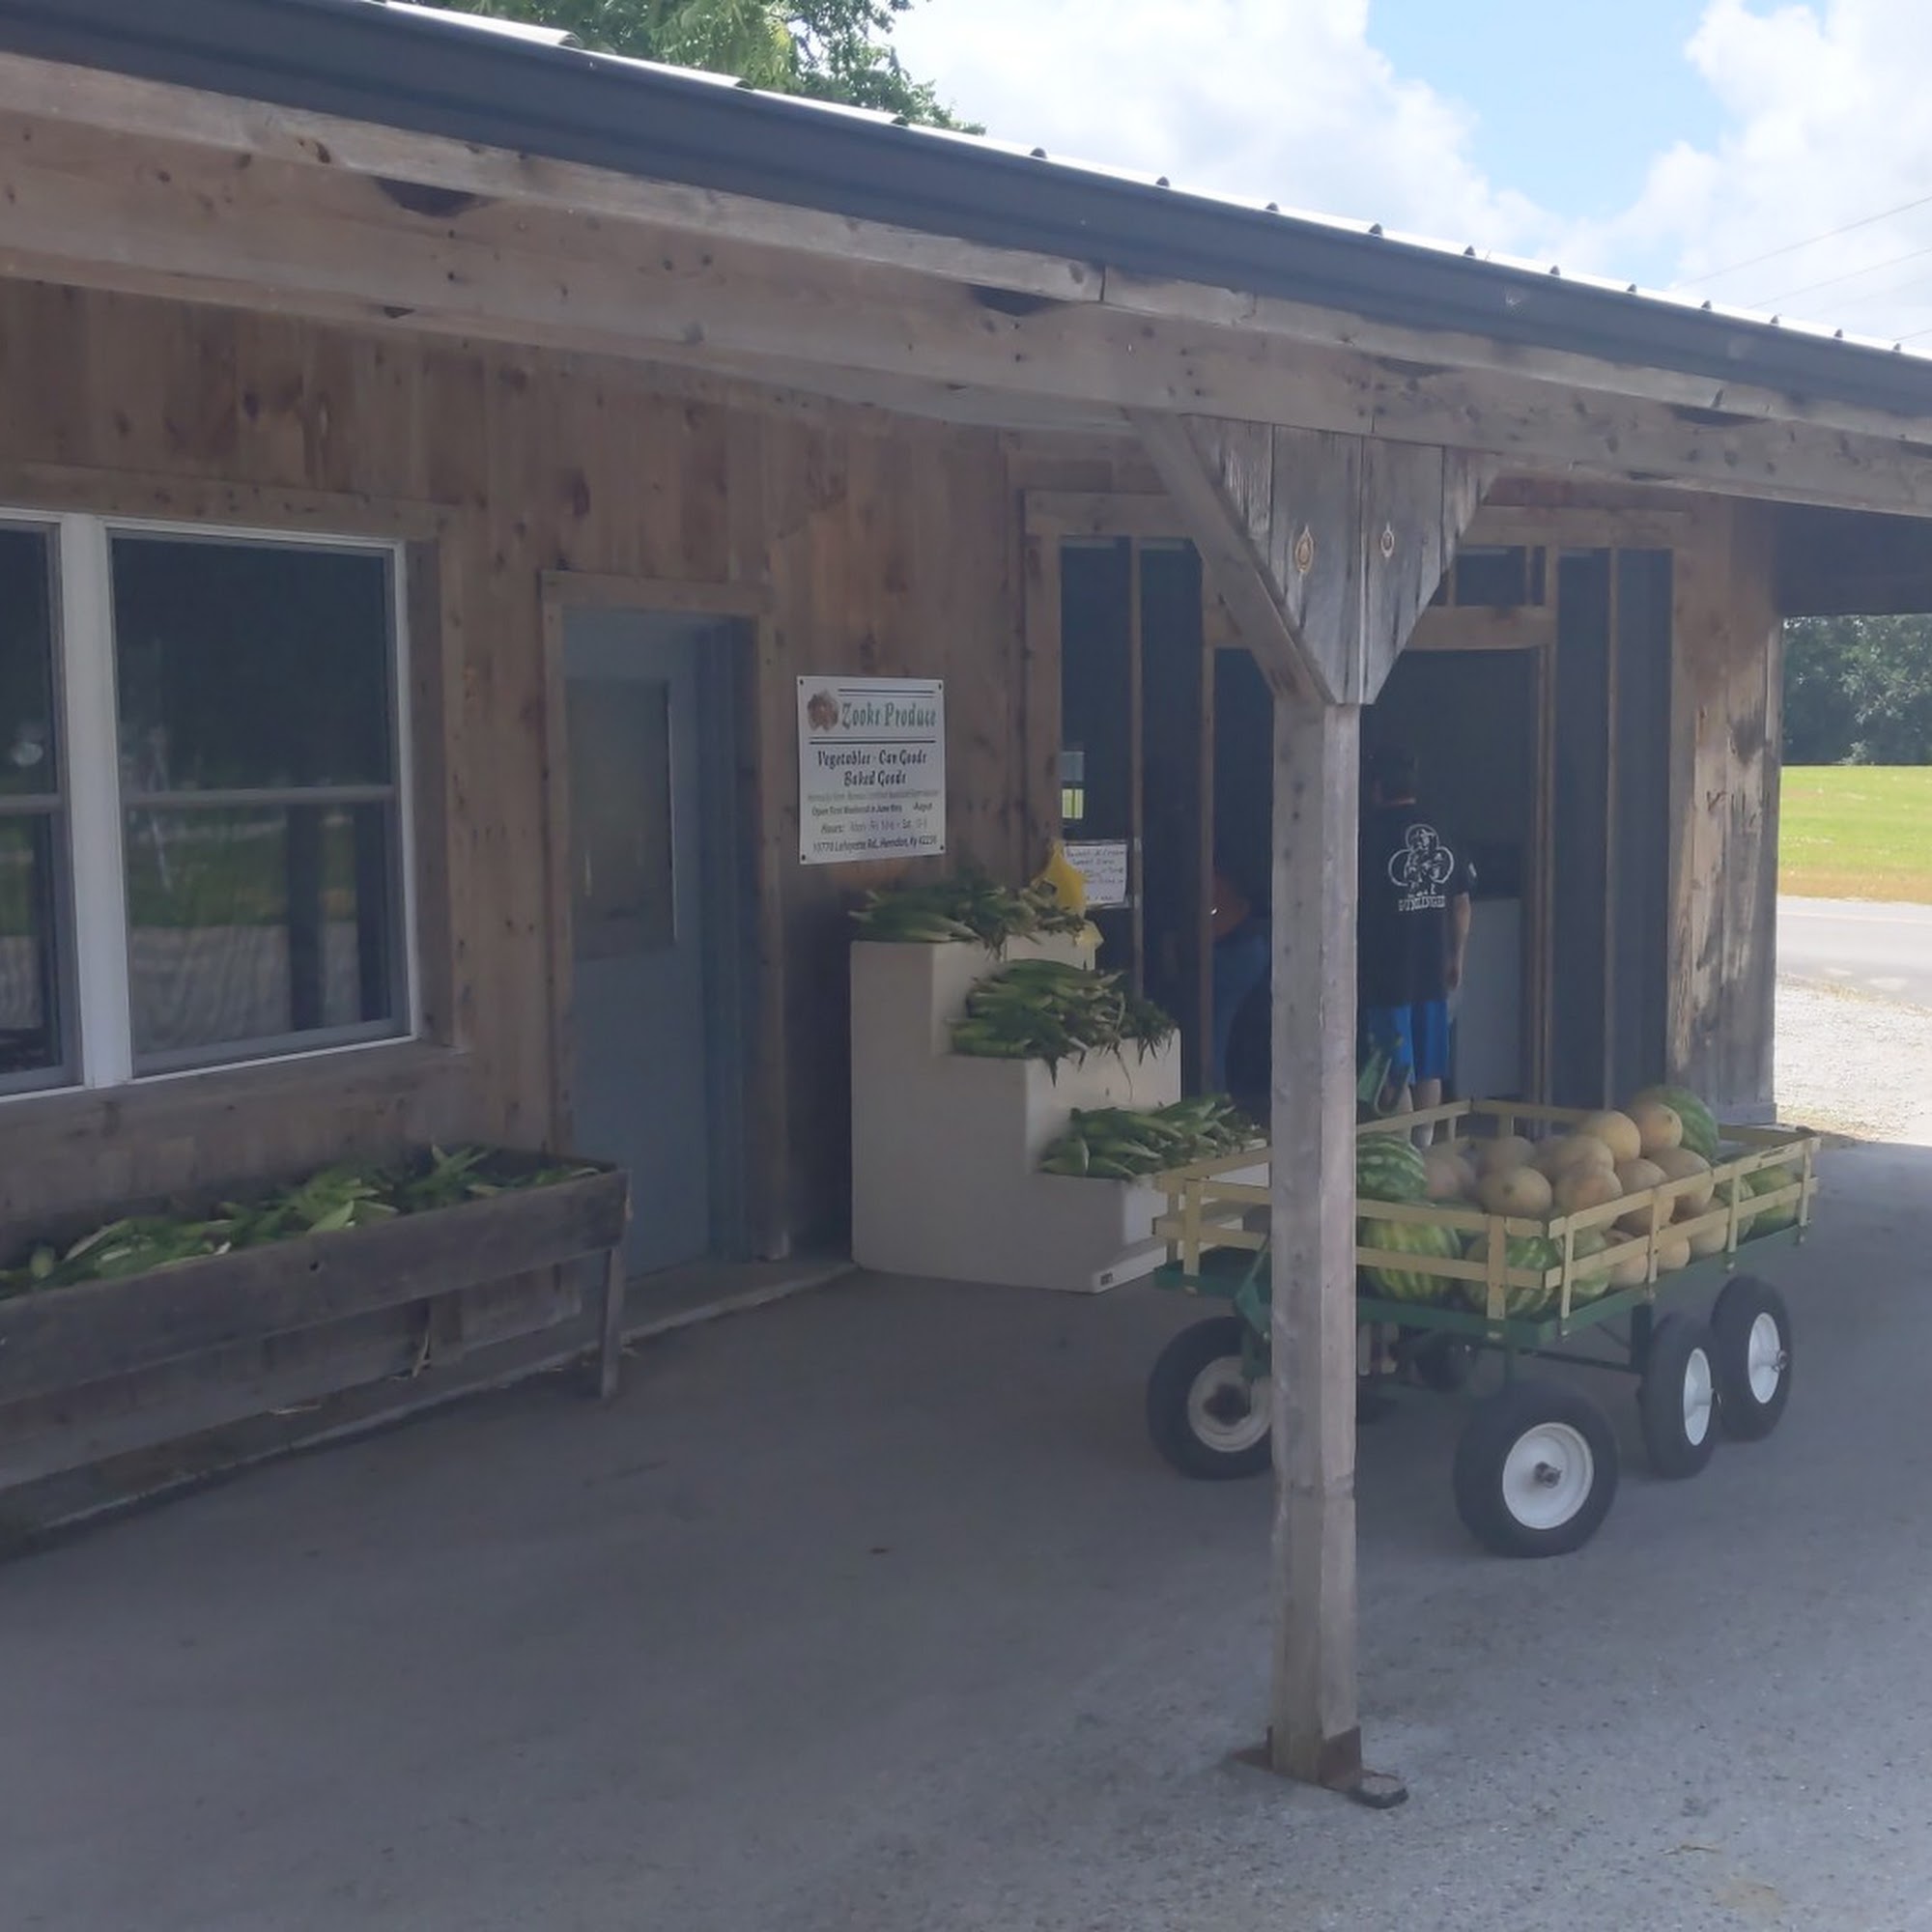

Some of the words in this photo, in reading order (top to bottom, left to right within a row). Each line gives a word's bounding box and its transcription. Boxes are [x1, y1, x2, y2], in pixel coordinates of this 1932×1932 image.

[841, 701, 881, 730] Zooks
[884, 701, 936, 727] Produce
[817, 750, 871, 770] Vegetables
[878, 749, 897, 765] Can
[899, 749, 927, 766] Goods
[843, 770, 875, 787] Baked
[877, 769, 907, 787] Goods
